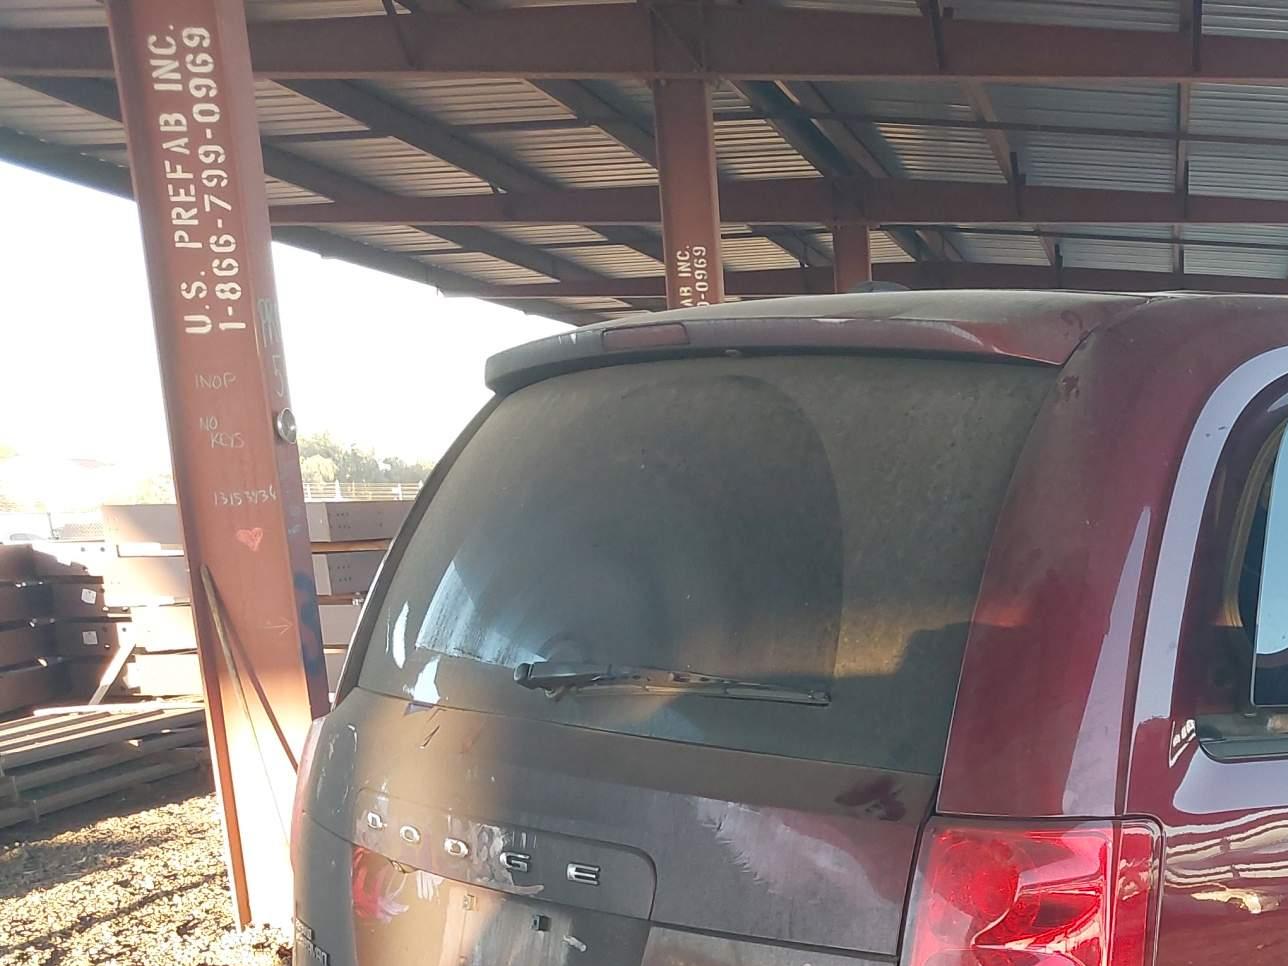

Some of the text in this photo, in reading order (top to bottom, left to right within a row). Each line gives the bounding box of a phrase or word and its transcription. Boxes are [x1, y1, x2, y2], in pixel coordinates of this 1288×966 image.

[147, 24, 212, 334] U.S. PREFAB INC.
[181, 26, 247, 331] 1-866-799-0969
[676, 245, 692, 277] INC.
[366, 810, 602, 888] DODGE
